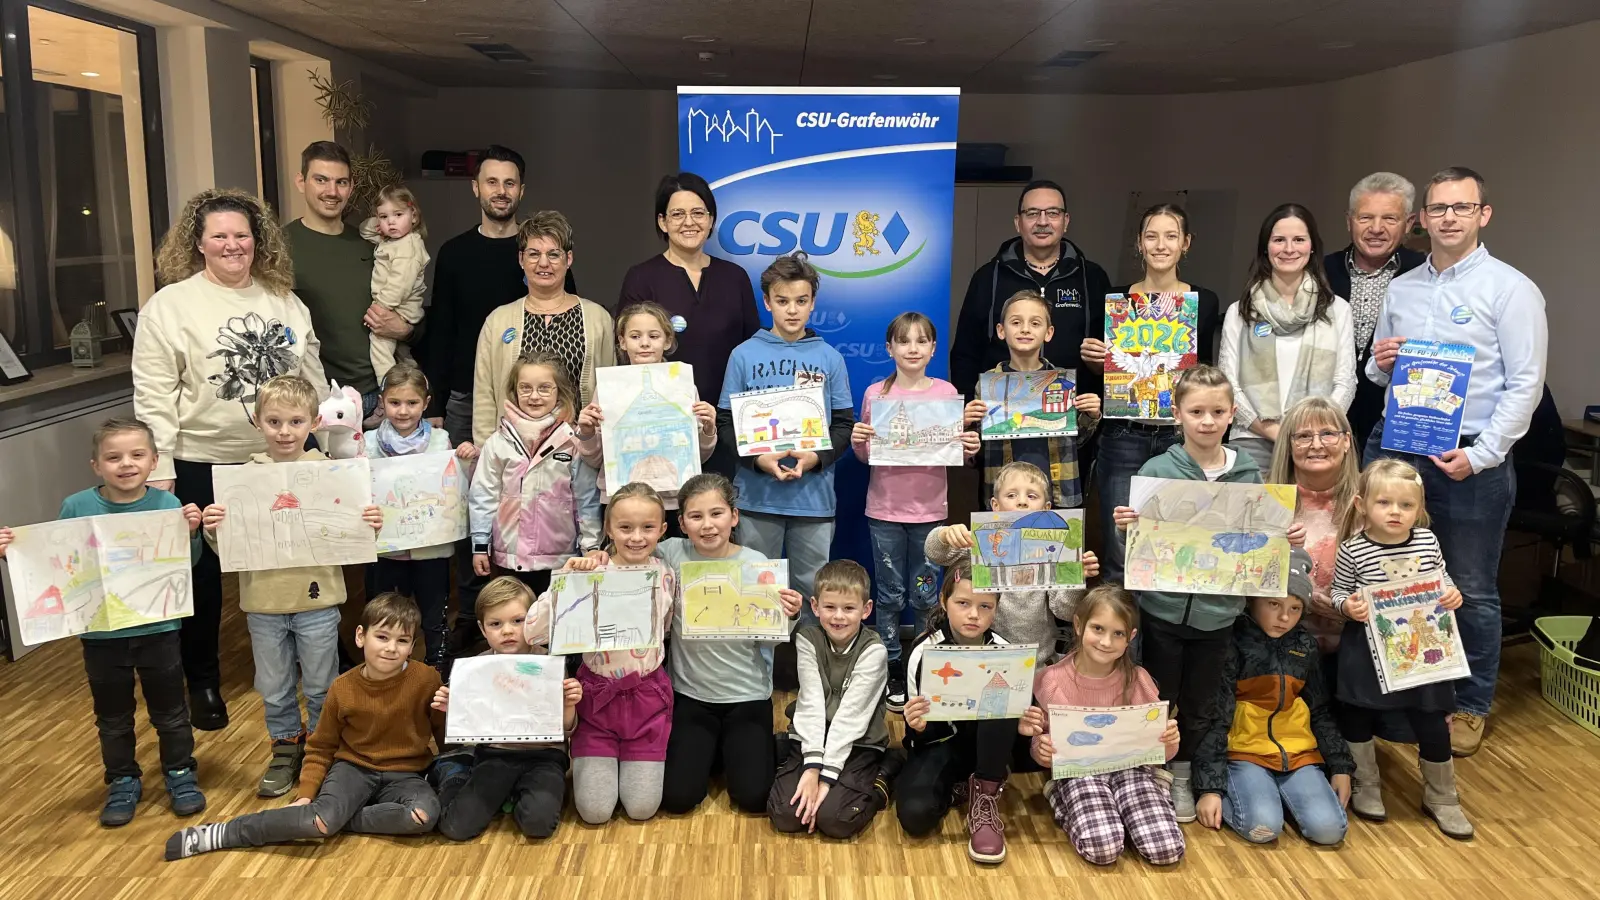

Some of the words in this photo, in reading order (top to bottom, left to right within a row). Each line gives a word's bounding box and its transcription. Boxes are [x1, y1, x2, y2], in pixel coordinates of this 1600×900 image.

[796, 112, 939, 128] CSU-Grafenwöhr
[717, 210, 849, 256] CSU
[834, 342, 875, 358] CSU
[1118, 324, 1189, 354] 2026
